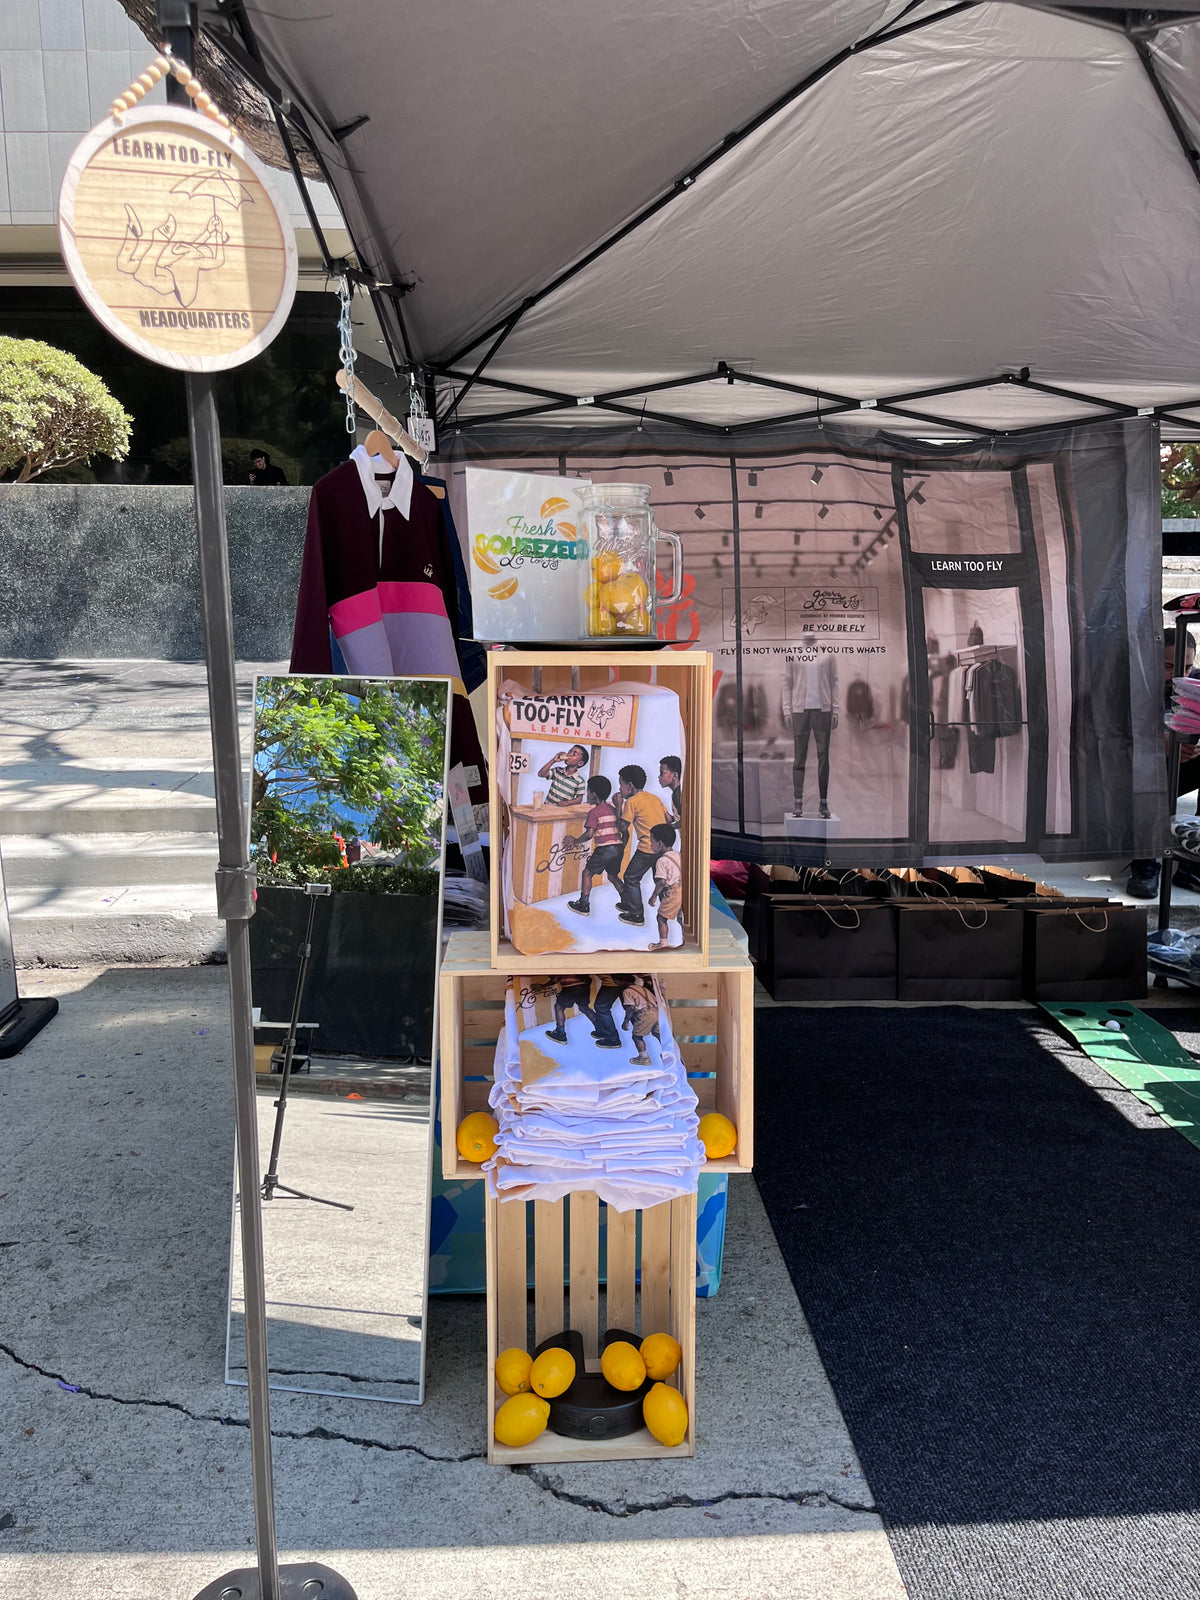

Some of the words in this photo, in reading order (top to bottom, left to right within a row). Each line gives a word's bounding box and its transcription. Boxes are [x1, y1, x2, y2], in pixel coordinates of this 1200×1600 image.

[139, 310, 251, 329] HEADQUARTERS
[506, 515, 557, 537] Fresh
[475, 533, 590, 560] SQUEEZED
[931, 560, 962, 571] LEARN
[963, 561, 984, 571] TOO
[986, 560, 1003, 571] FLY
[802, 624, 815, 632] BE
[816, 624, 835, 632] YOU
[837, 624, 848, 632] BE
[849, 624, 866, 632] FLY
[742, 647, 751, 655] IS
[752, 647, 770, 655] NOT
[772, 646, 803, 654] WHATS
[805, 646, 819, 654] ON
[820, 646, 840, 654] YOU
[841, 646, 855, 654] ITS
[856, 646, 886, 654] WHATS
[512, 700, 586, 728] TOO-FLY
[531, 724, 612, 739] LEMONADE
